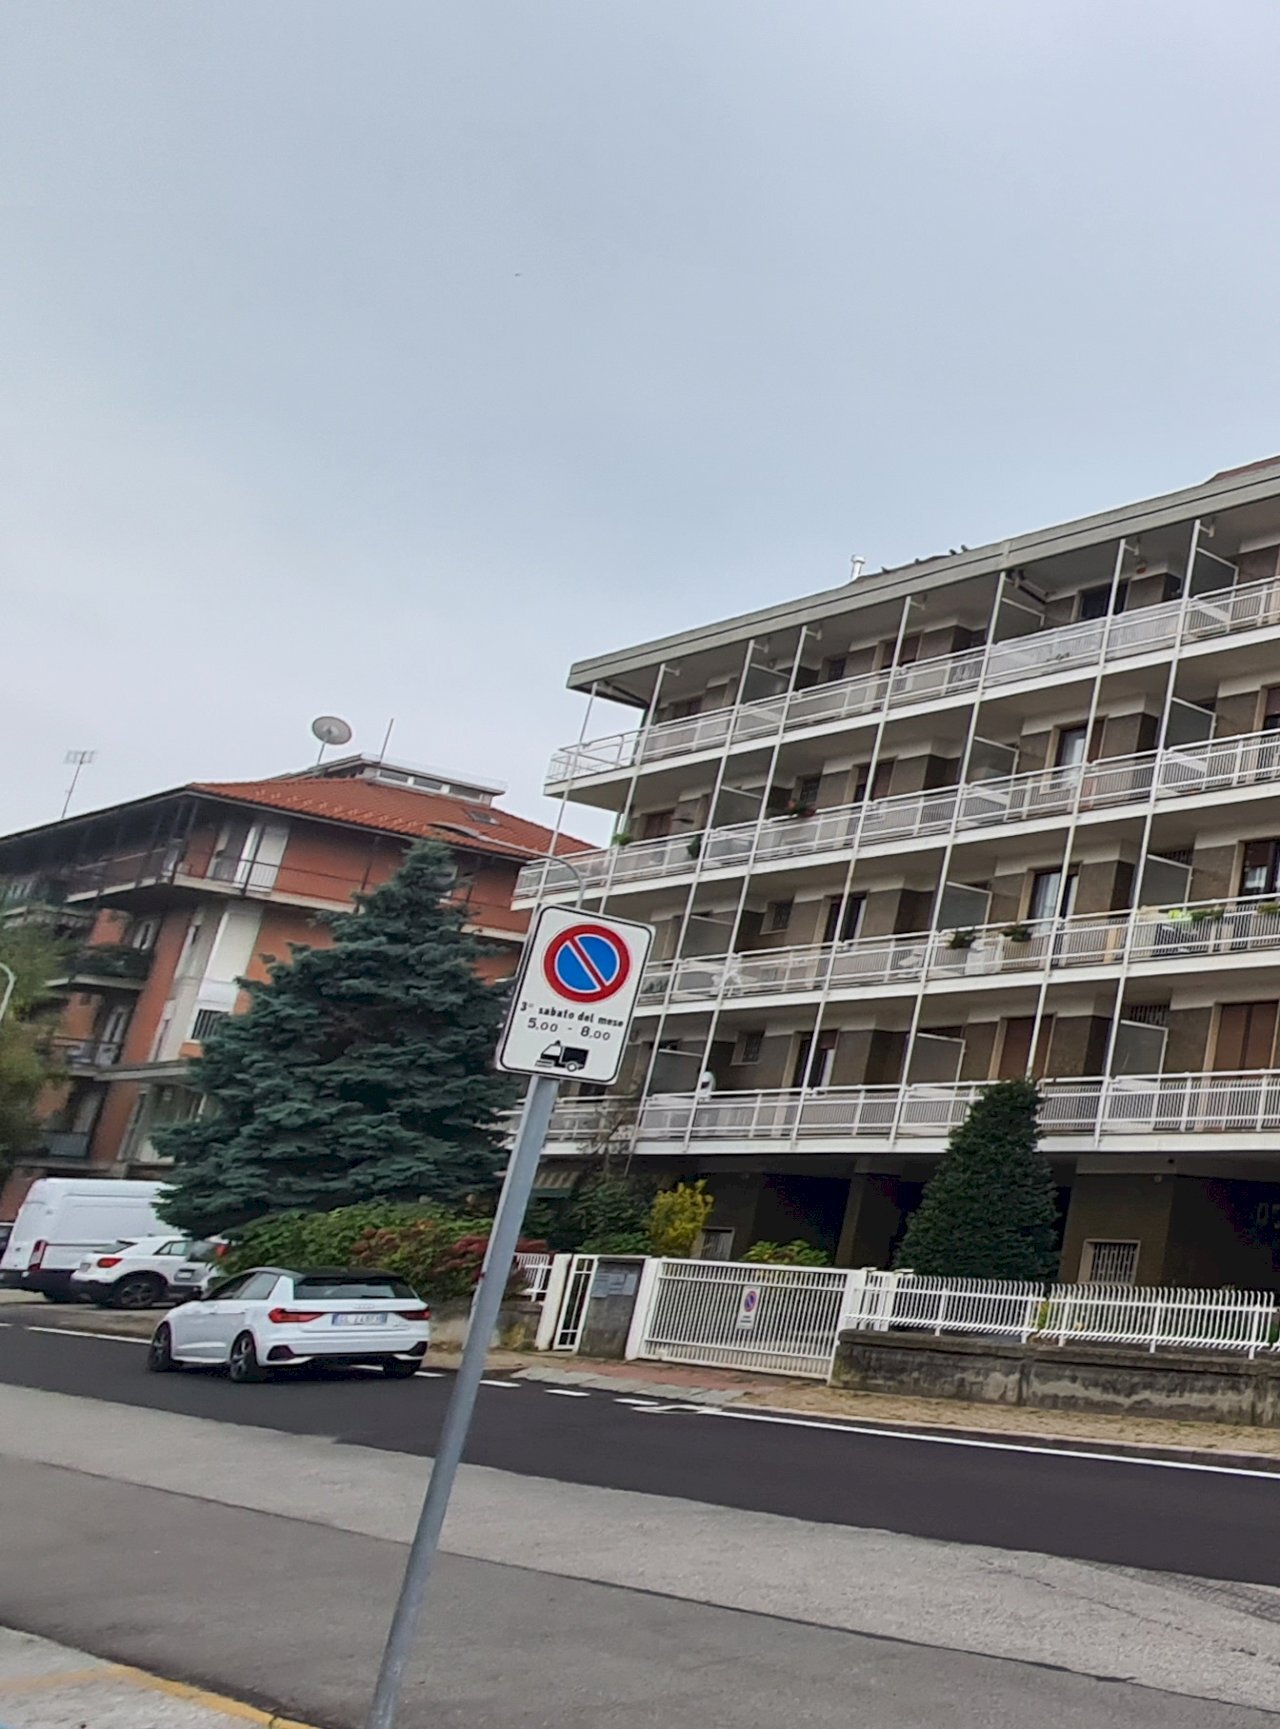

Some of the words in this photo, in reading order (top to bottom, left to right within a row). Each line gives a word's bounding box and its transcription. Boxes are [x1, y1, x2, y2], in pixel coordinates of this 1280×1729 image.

[538, 1007, 575, 1019] sabato
[577, 1011, 594, 1023] del
[598, 1016, 624, 1027] mese
